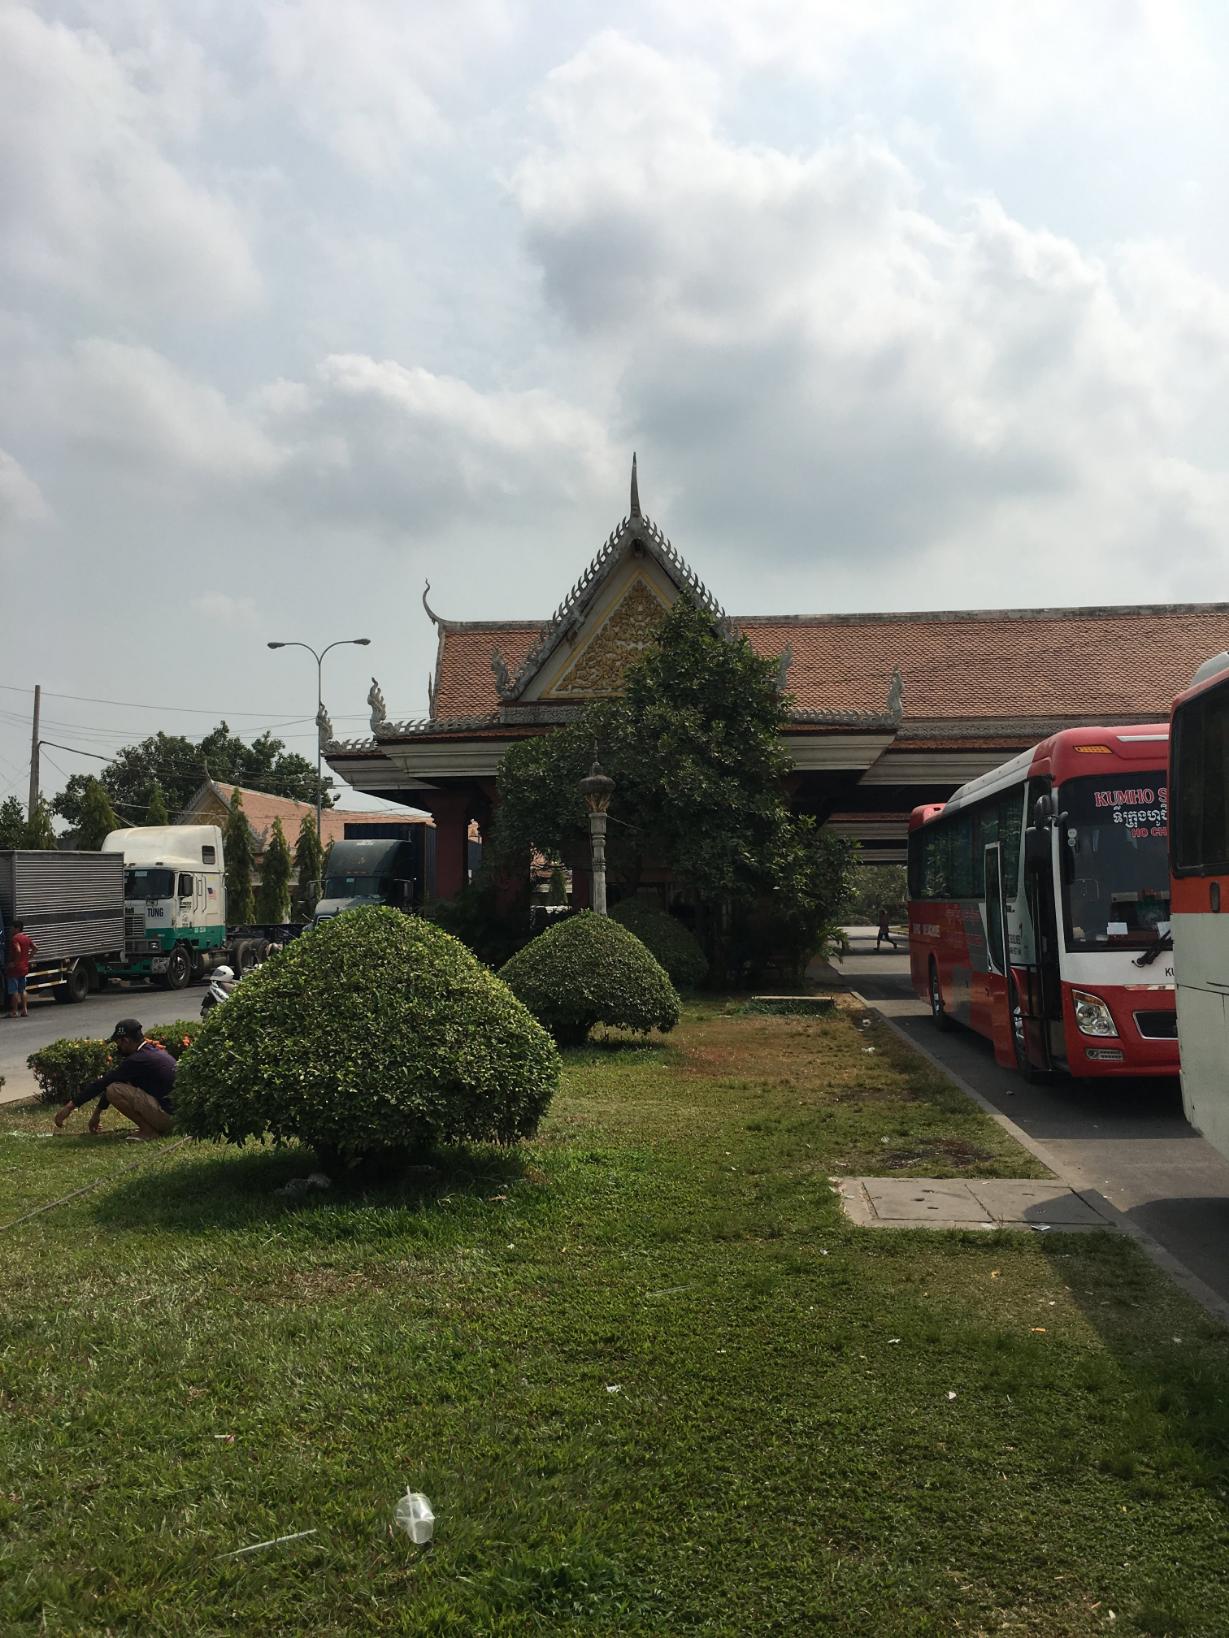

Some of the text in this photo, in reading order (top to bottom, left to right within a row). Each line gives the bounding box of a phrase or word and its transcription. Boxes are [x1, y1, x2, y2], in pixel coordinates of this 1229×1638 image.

[1094, 787, 1168, 807] KUMHO S
[1131, 826, 1169, 838] HO CH
